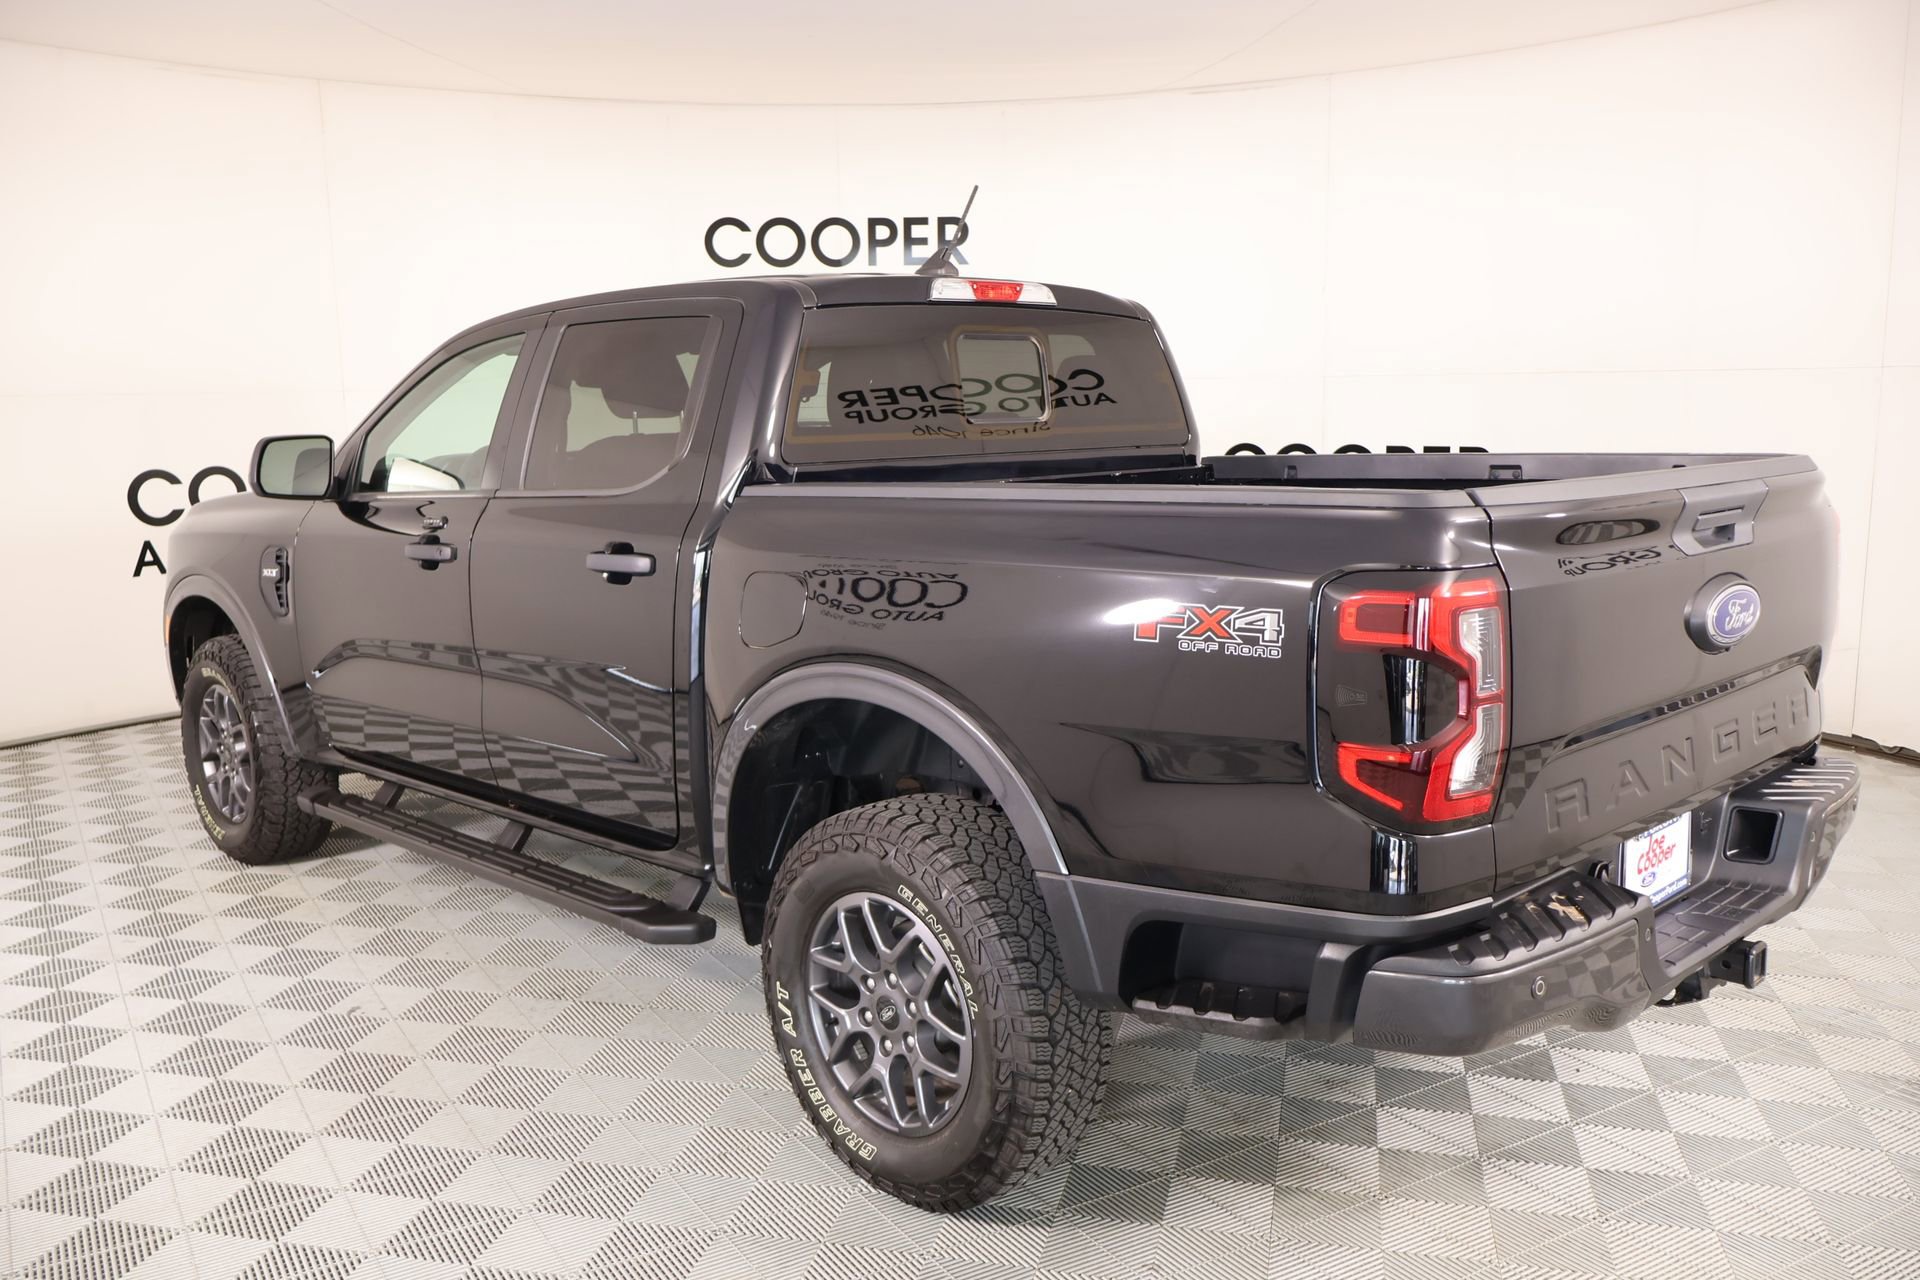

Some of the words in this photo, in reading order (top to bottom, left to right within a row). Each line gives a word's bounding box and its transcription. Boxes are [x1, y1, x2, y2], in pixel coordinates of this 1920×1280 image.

[704, 216, 969, 268] COOPER
[262, 568, 279, 577] XLT
[1133, 602, 1285, 647] FX4
[1178, 640, 1219, 653] OFF
[1224, 643, 1282, 659] ROAD
[1545, 687, 1809, 833] RANGER
[1637, 843, 1677, 875] Cooper
[1645, 834, 1665, 857] Joe
[897, 884, 978, 1020] GENERAL
[776, 981, 797, 1038] A/T
[790, 1048, 877, 1161] GRABBER
